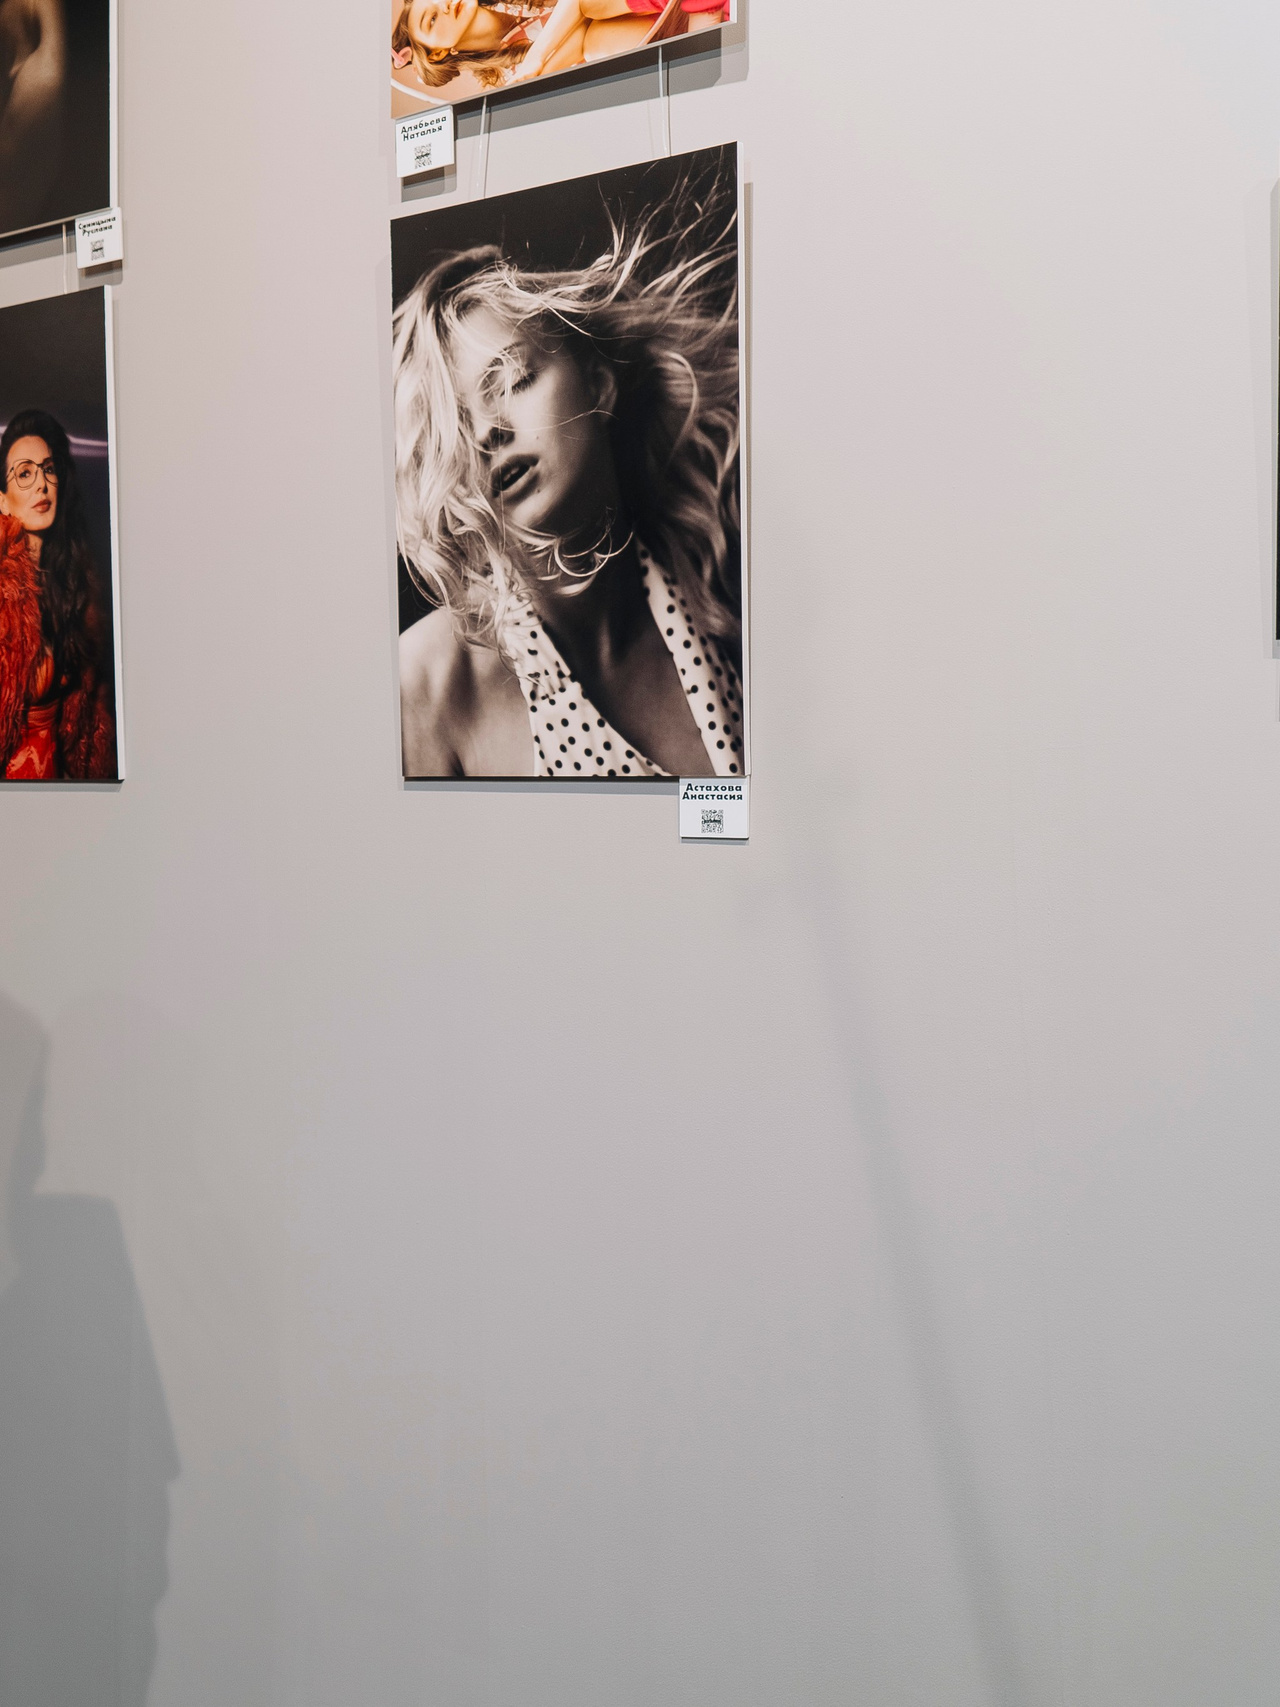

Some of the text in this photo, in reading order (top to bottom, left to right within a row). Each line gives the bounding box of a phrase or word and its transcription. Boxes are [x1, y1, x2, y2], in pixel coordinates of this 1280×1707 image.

[403, 125, 443, 141] Наталья
[686, 783, 742, 792] Астахова
[682, 792, 743, 800] Анастасия
